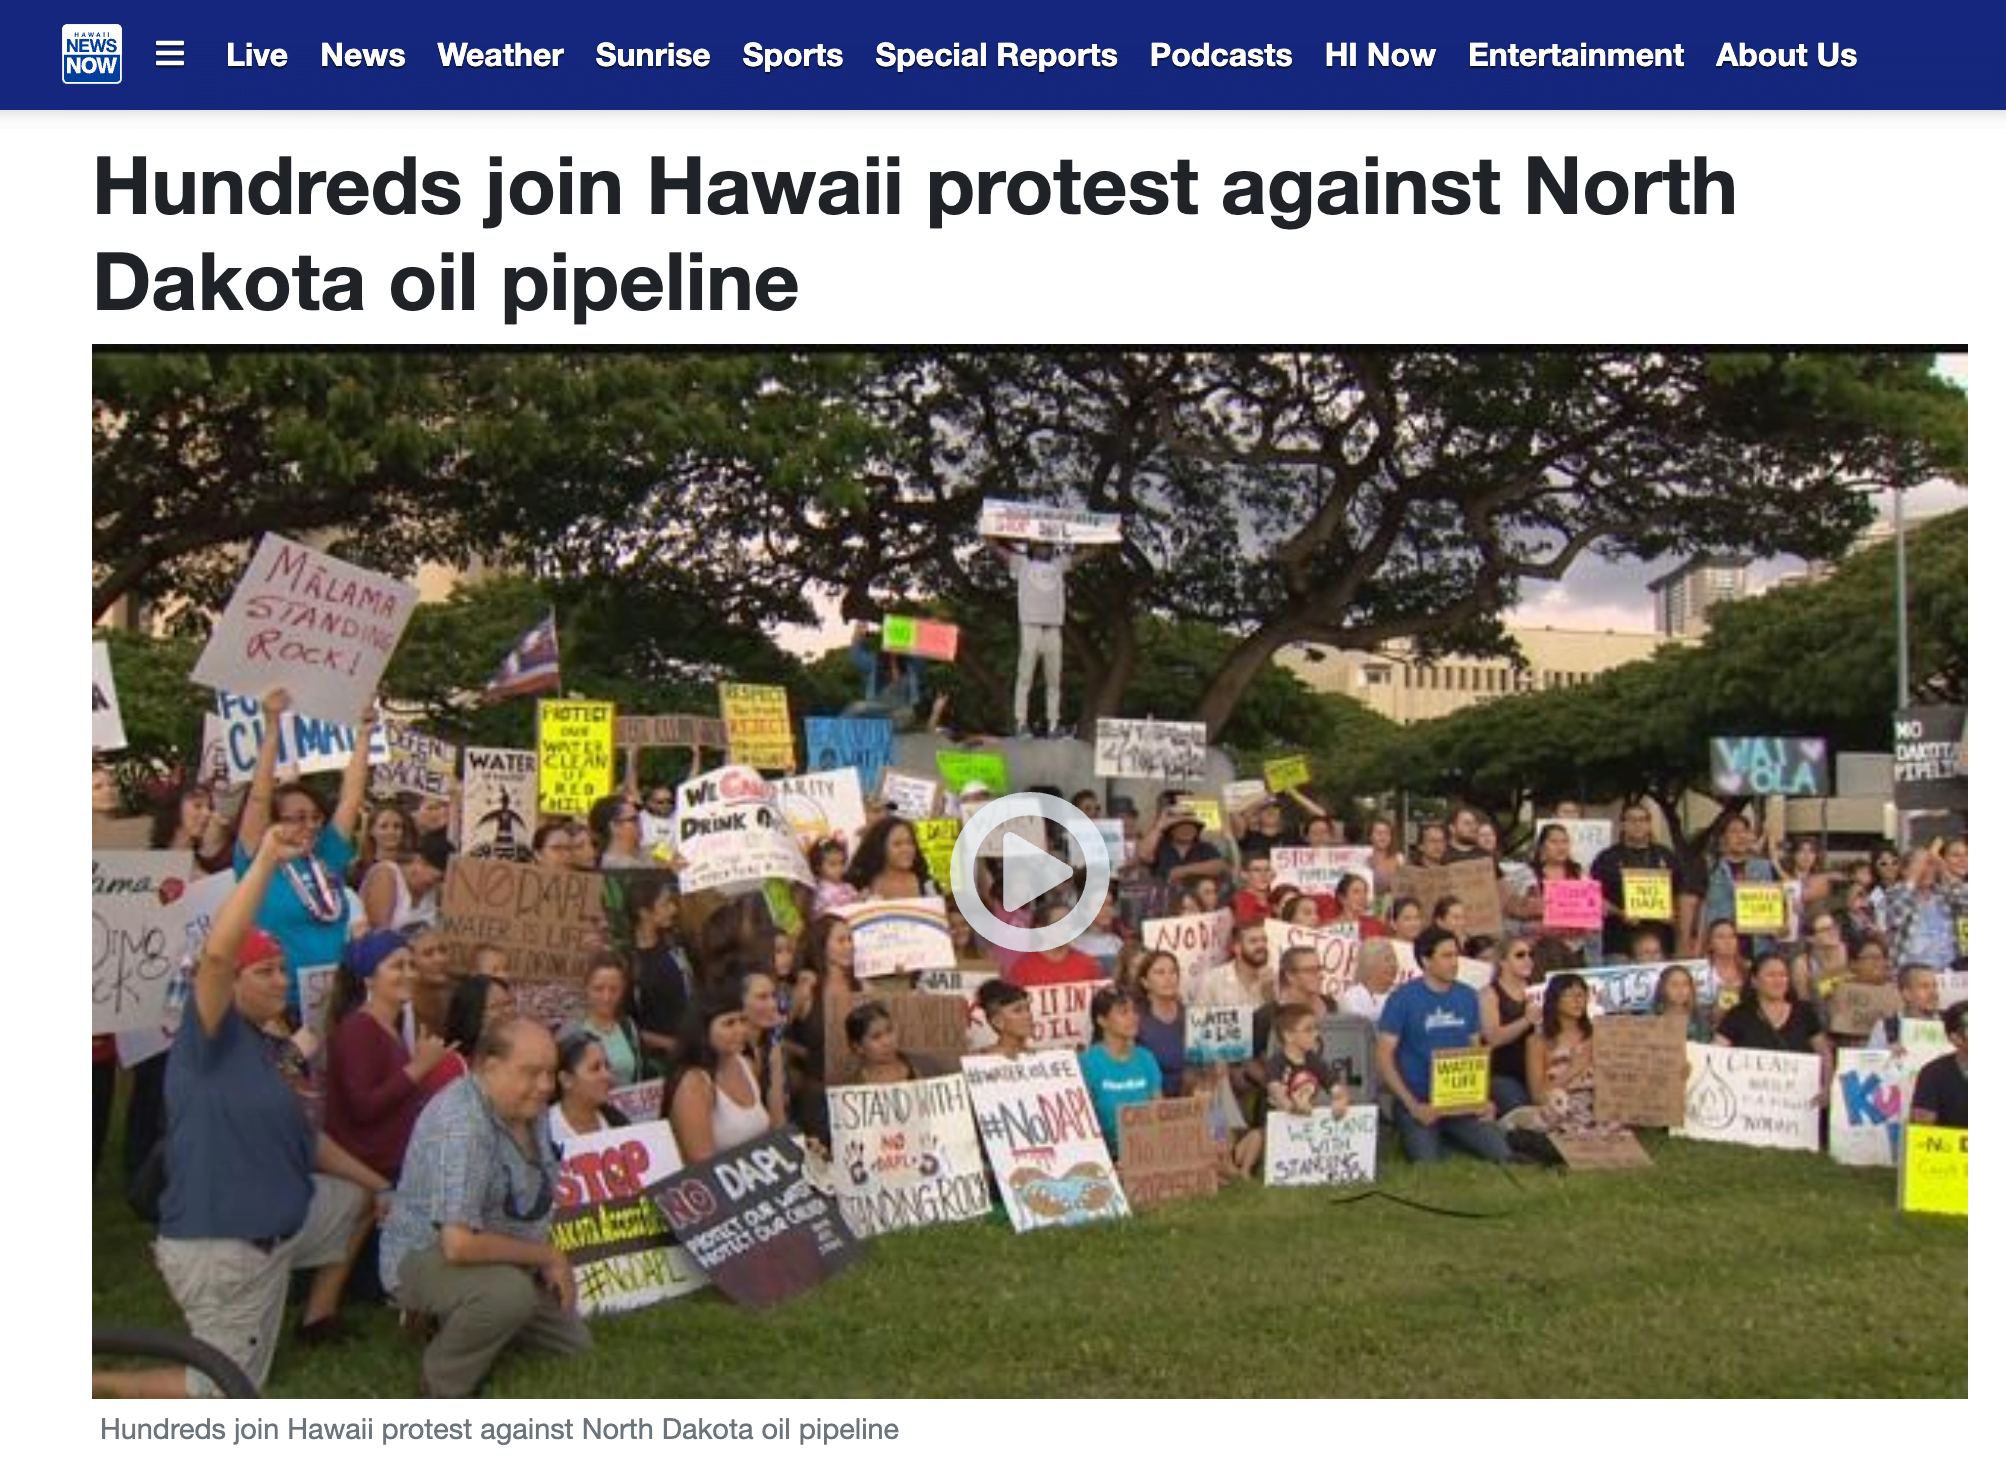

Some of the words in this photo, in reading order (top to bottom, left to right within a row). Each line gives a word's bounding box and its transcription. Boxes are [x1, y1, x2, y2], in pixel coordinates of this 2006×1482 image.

[246, 594, 394, 652] STANDING
[246, 626, 362, 677] ROCK!
[228, 714, 386, 772] CLIMAE
[469, 751, 538, 773] WATER
[1754, 767, 1818, 794] OLA
[680, 811, 747, 842] DRINK
[842, 1088, 911, 1131] STAND
[555, 1141, 650, 1211] STOP
[654, 1178, 718, 1230] NO
[713, 1146, 799, 1200] DAPL
